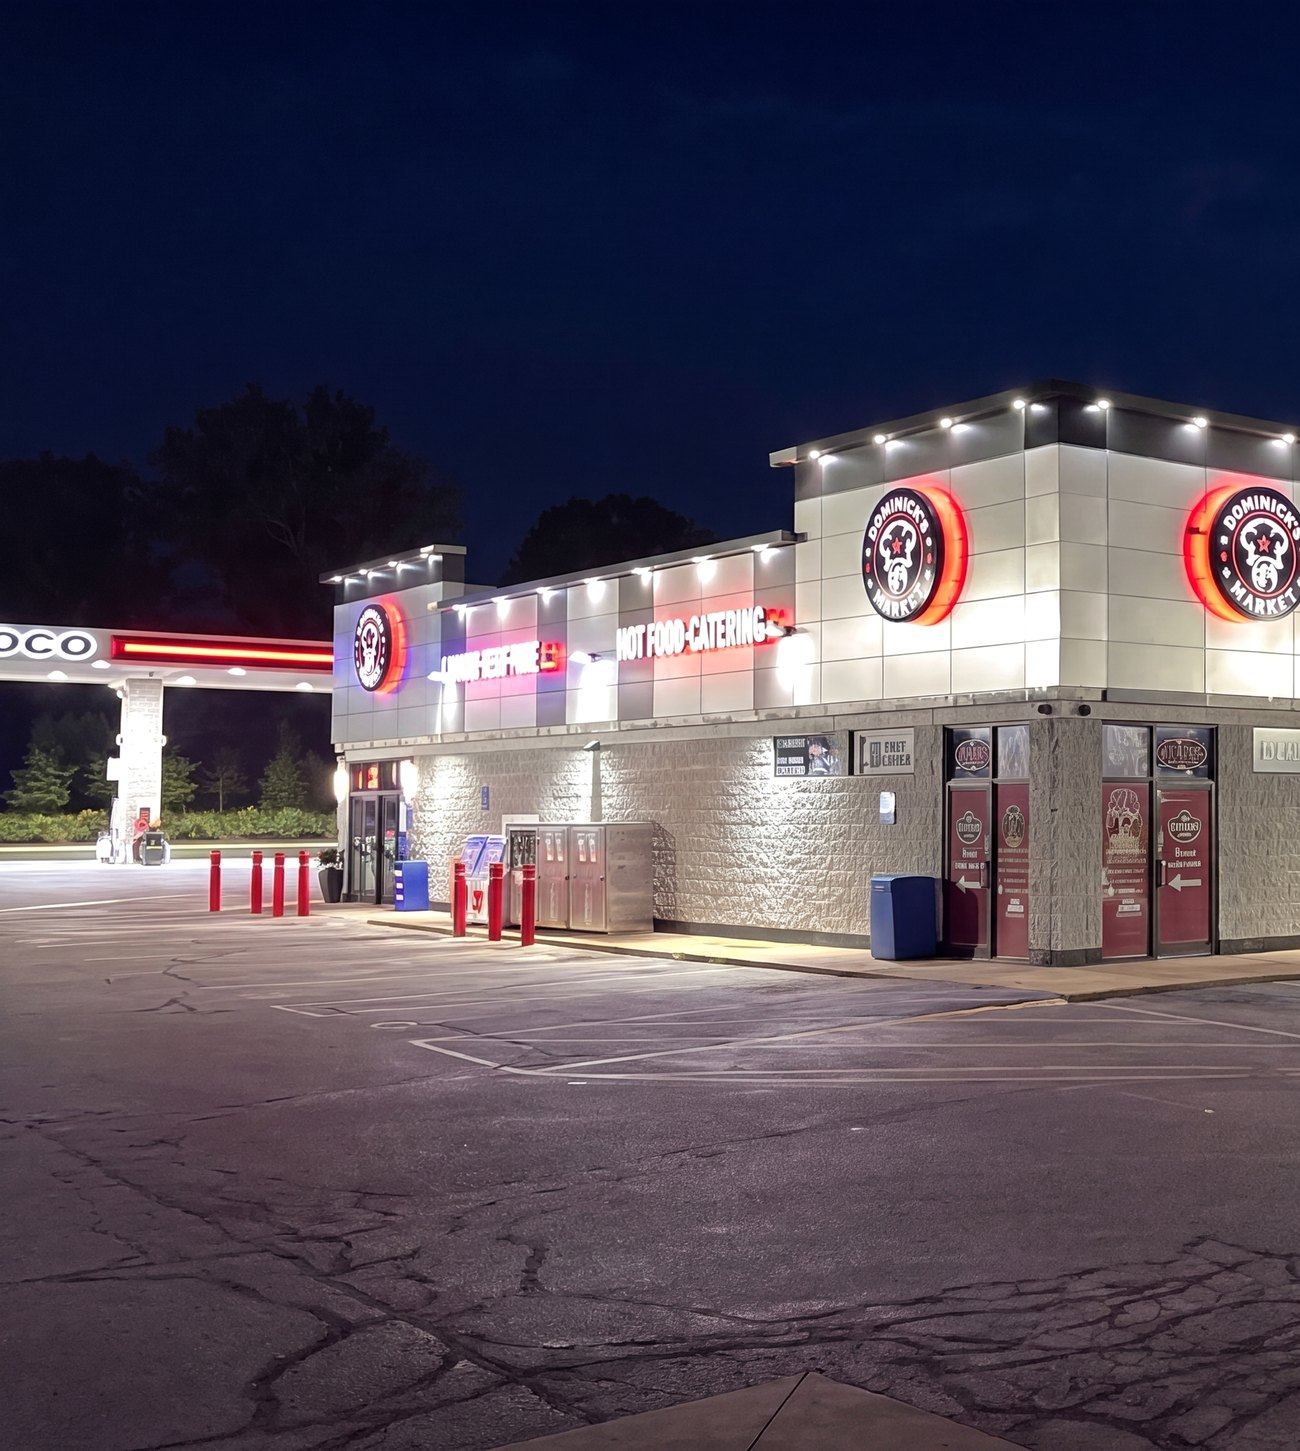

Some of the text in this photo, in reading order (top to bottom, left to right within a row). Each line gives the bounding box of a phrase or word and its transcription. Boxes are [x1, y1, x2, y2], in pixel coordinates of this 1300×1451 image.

[867, 496, 930, 542] DOMINICK'S
[873, 582, 925, 617] MARKET
[1230, 580, 1298, 615] MARKET
[616, 624, 646, 661] HOT
